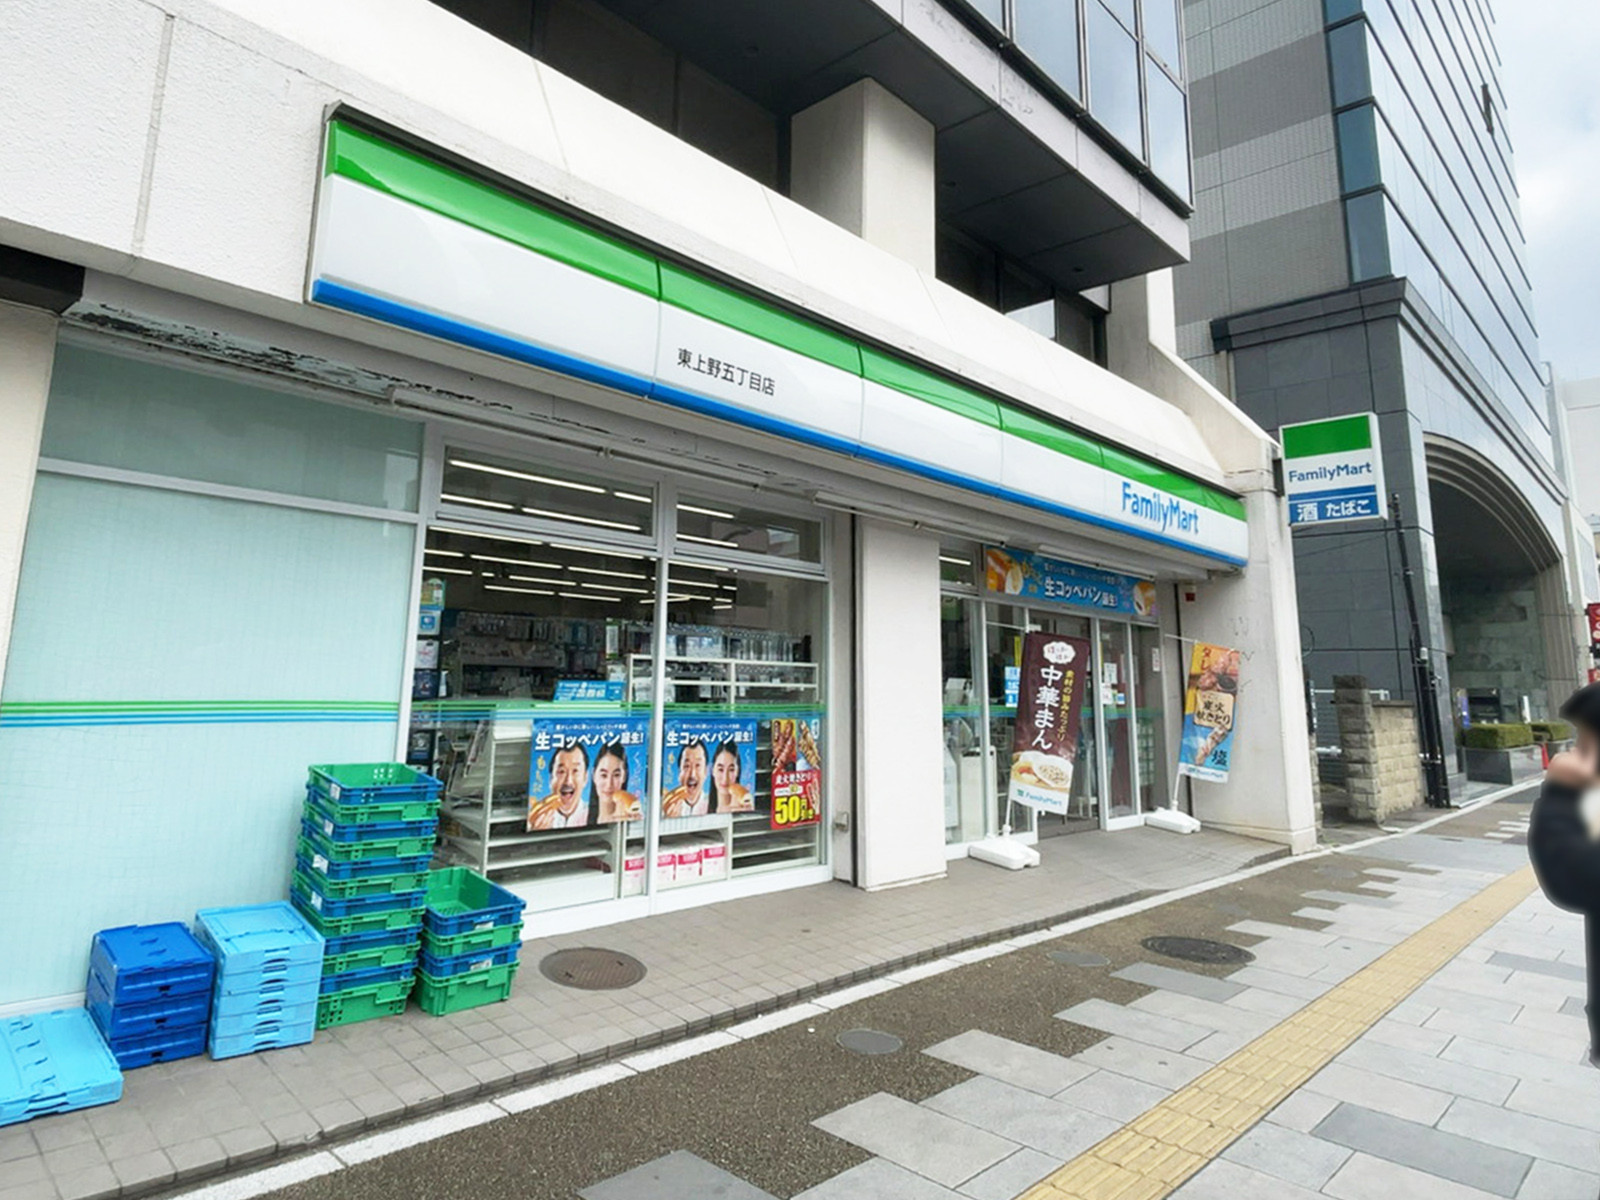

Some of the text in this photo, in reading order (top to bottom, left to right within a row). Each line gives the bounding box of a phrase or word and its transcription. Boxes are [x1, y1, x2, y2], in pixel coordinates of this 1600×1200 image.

[677, 348, 775, 396] 東上野五丁目店
[1289, 462, 1372, 483] FamilyMart
[1122, 481, 1199, 534] FamilyMart
[1297, 499, 1371, 521] 酒 たばこ
[1031, 665, 1063, 750] 中華まん
